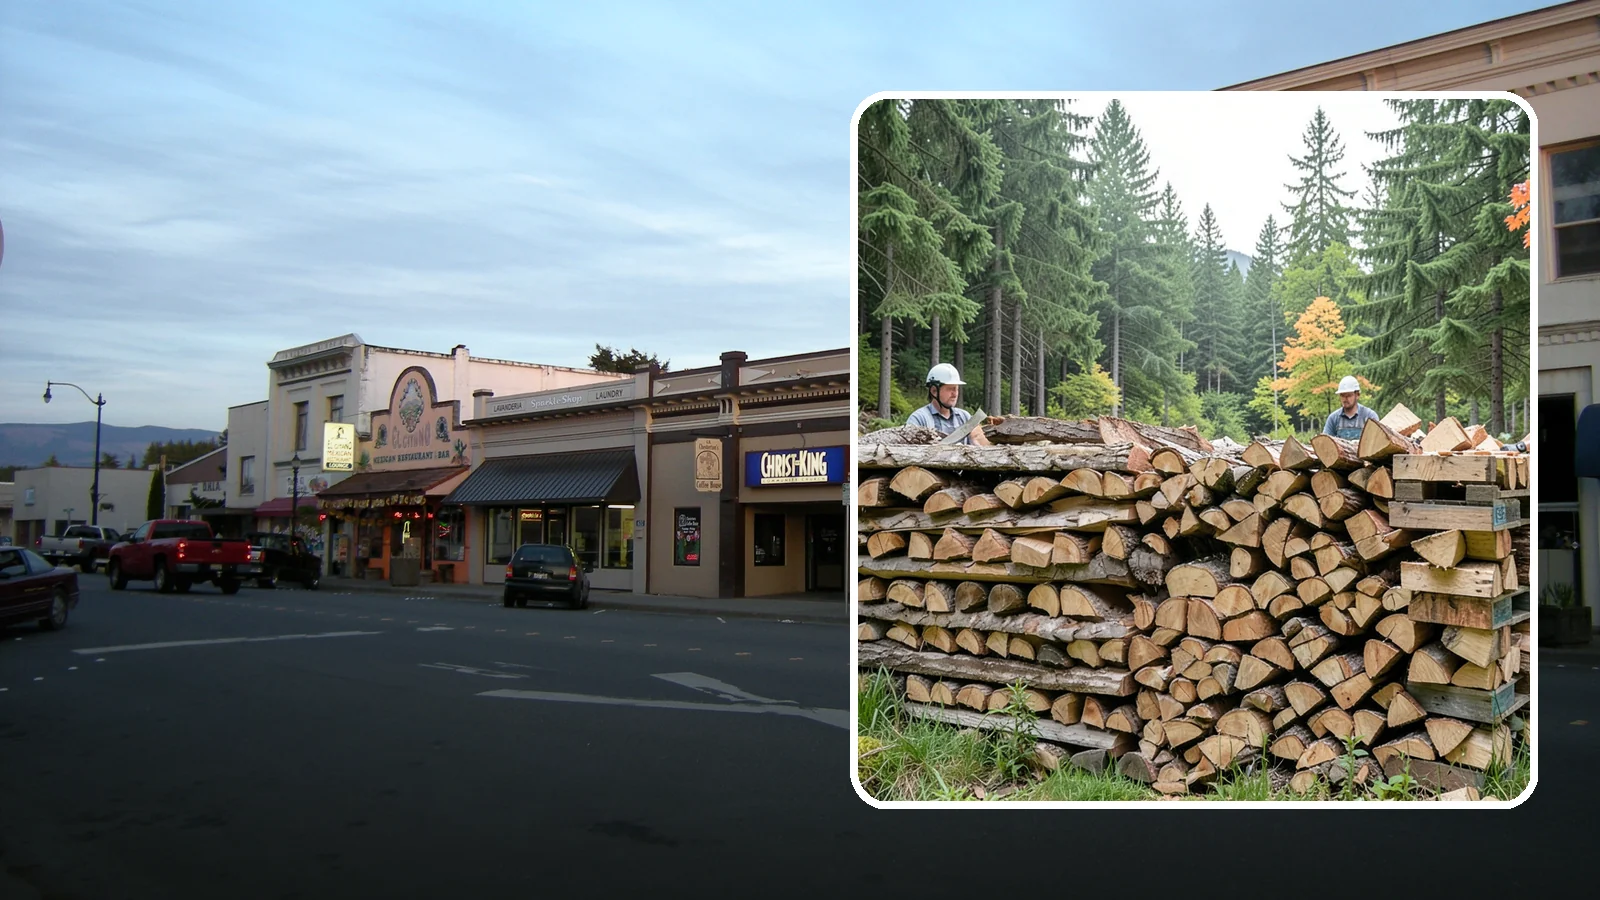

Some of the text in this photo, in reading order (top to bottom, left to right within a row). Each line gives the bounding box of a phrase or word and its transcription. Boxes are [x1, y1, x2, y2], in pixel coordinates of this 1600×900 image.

[530, 394, 583, 409] Sparkle Shop
[595, 389, 623, 400] LAUNDRY
[493, 402, 522, 412] LAVANDERIA
[373, 450, 450, 465] MEXICAN RESTAURANT BAR
[761, 450, 827, 478] CHRIST KING
